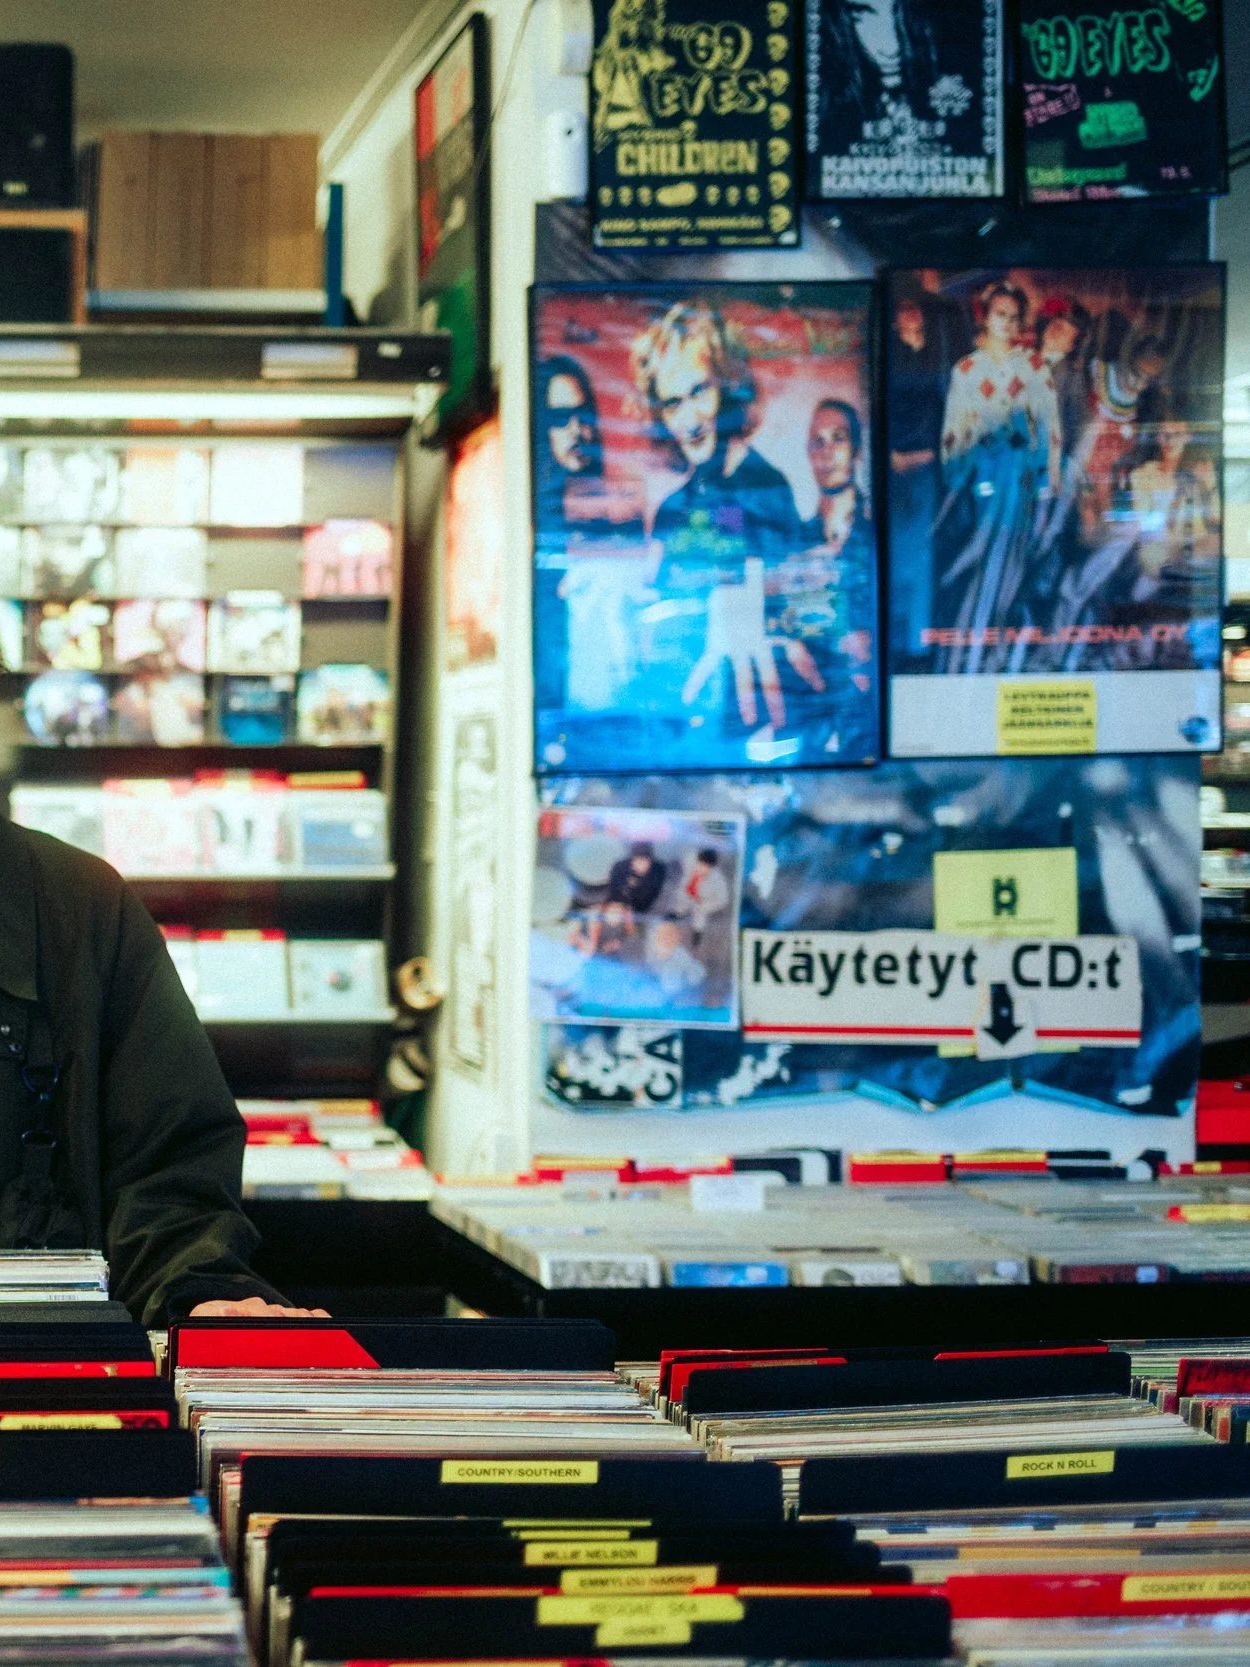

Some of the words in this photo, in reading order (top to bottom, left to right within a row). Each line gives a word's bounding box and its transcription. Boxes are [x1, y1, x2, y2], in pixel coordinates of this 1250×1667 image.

[822, 155, 988, 175] KAIVOPUISTON
[753, 940, 978, 999] Käytetyt
[1012, 944, 1121, 989] CD:t
[1022, 1462, 1054, 1471] ROCK
[1057, 1461, 1065, 1469] N
[1068, 1459, 1097, 1469] ROLL
[585, 1549, 638, 1560] NELSON
[1141, 1582, 1204, 1593] COUNTRY
